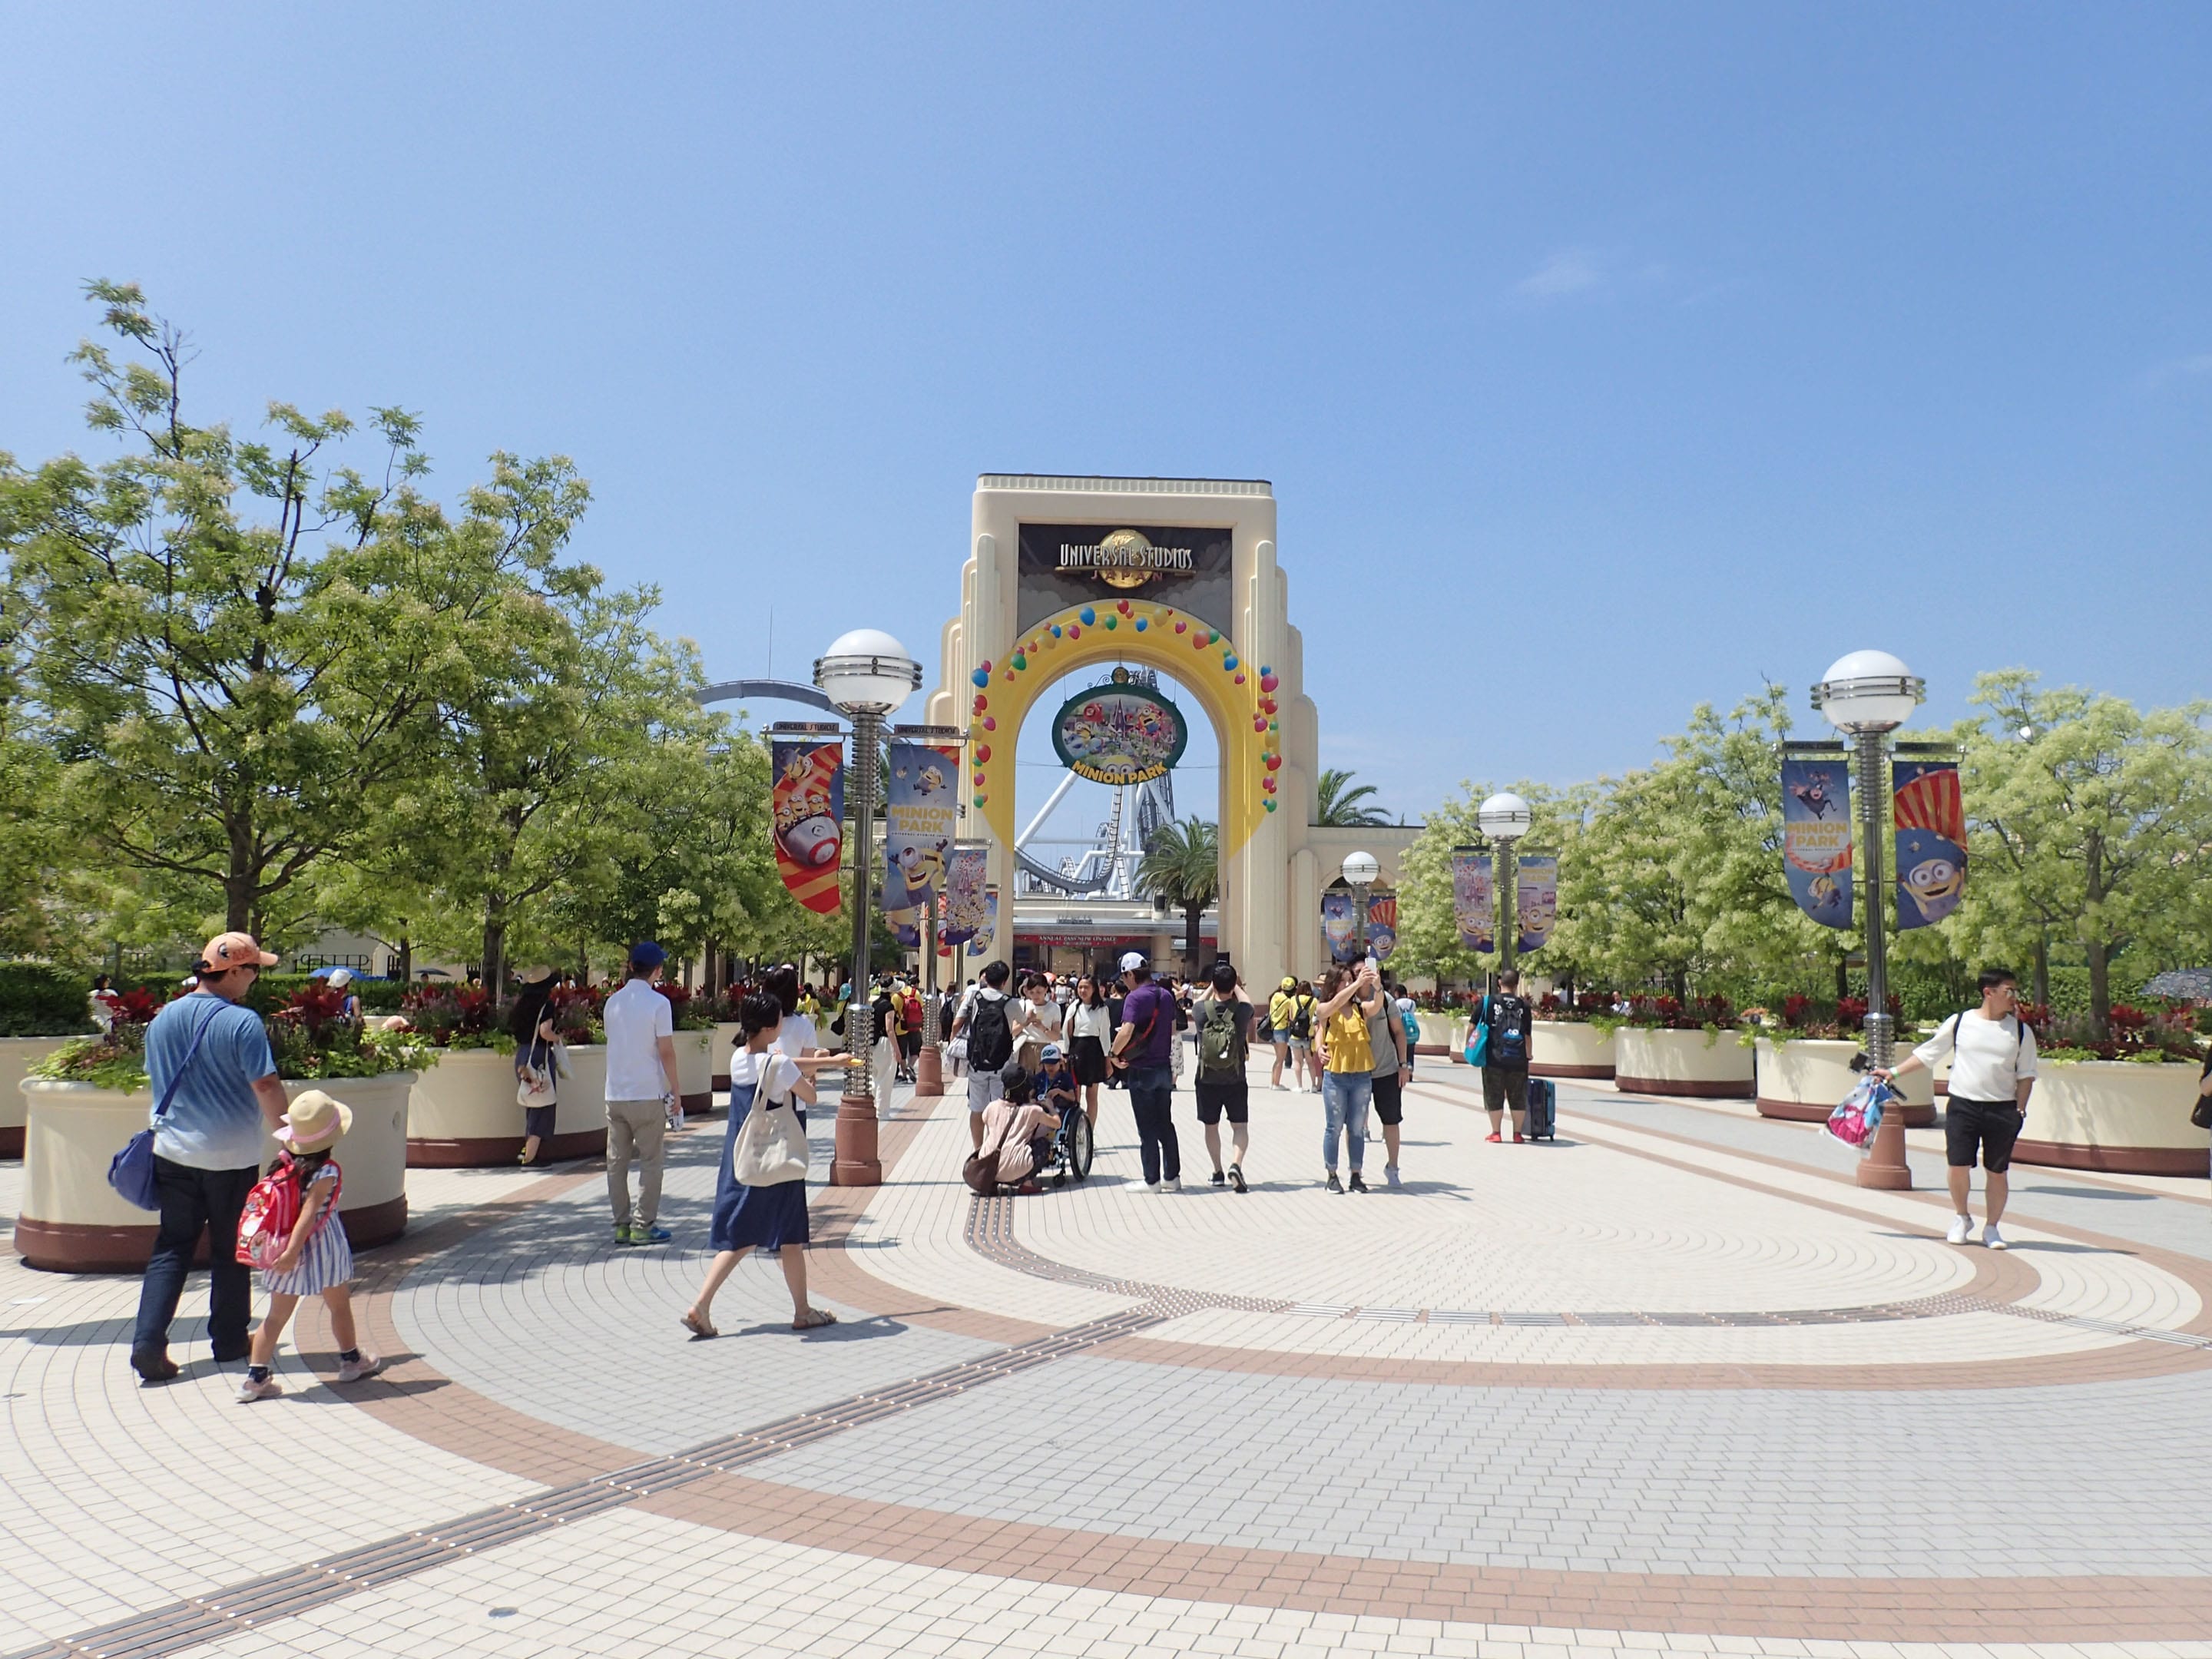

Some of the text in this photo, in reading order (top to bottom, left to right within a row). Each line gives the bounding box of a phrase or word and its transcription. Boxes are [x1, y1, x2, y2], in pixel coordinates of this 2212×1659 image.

[1060, 543, 1193, 569] UNIVERSAL STUDIOS
[1091, 570, 1163, 581] JAPAN
[1071, 760, 1168, 784] MINION PARK
[891, 805, 953, 821] MINION
[899, 820, 944, 833] PARK
[1786, 823, 1847, 834] MINION
[1796, 835, 1839, 847] PARK
